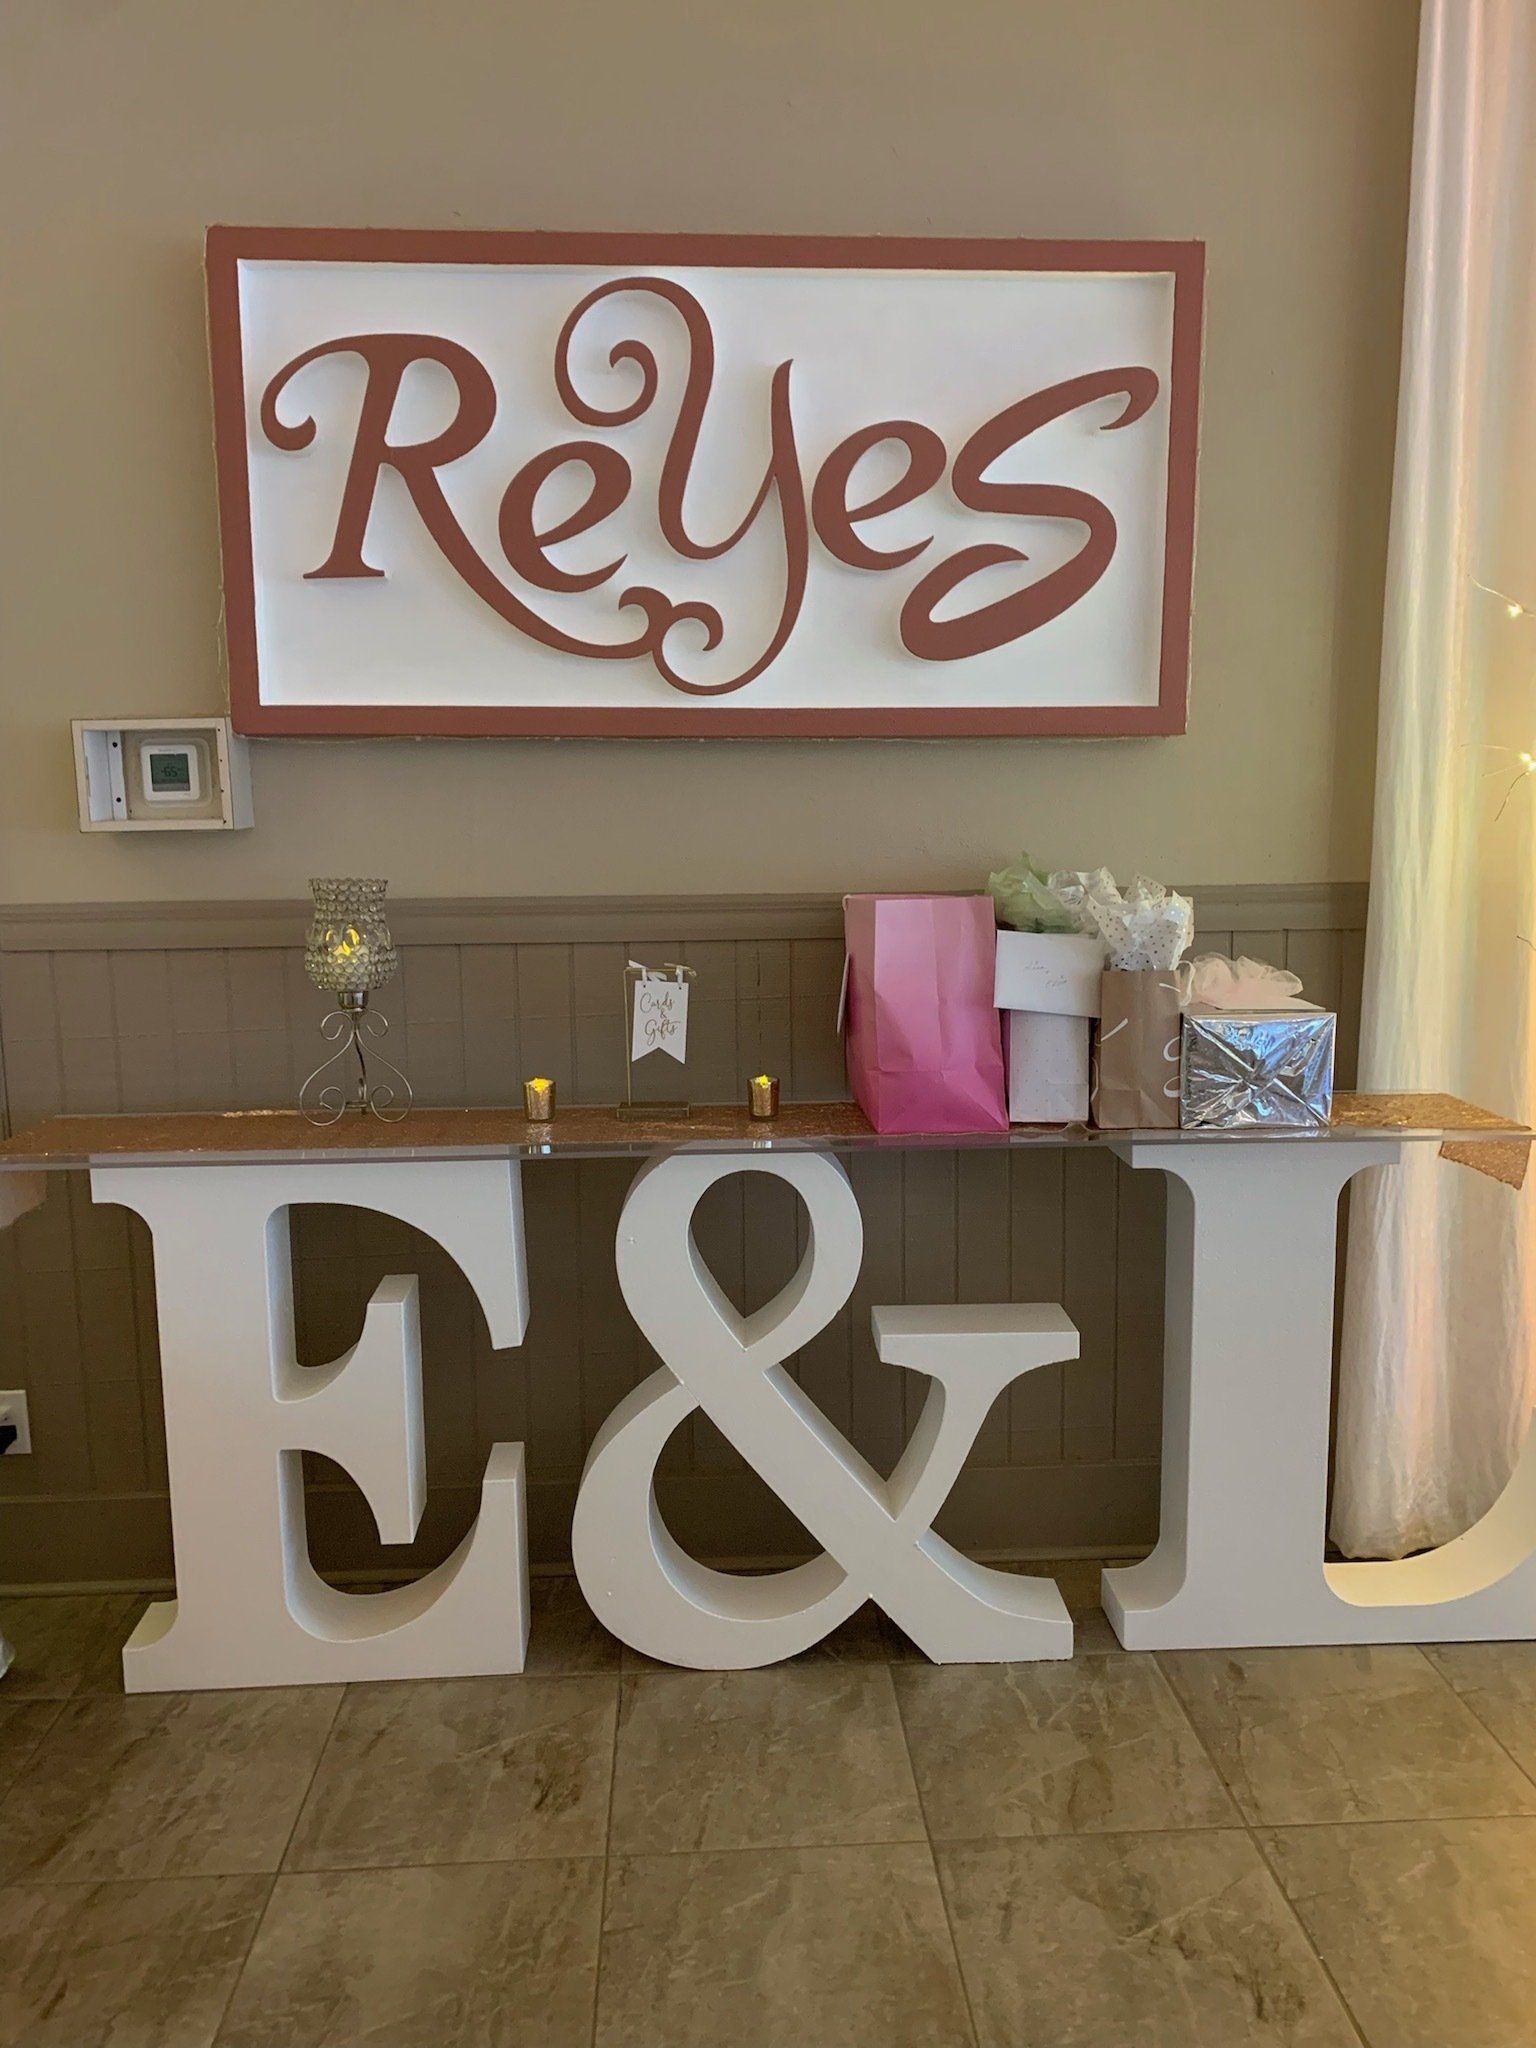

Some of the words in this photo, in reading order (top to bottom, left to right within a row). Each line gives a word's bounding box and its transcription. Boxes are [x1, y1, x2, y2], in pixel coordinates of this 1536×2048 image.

[639, 991, 674, 1014] Cards
[644, 1018, 681, 1046] Gifts
[90, 1152, 531, 1694] E
[572, 1150, 1081, 1671] &
[1102, 1140, 1536, 1652] L
